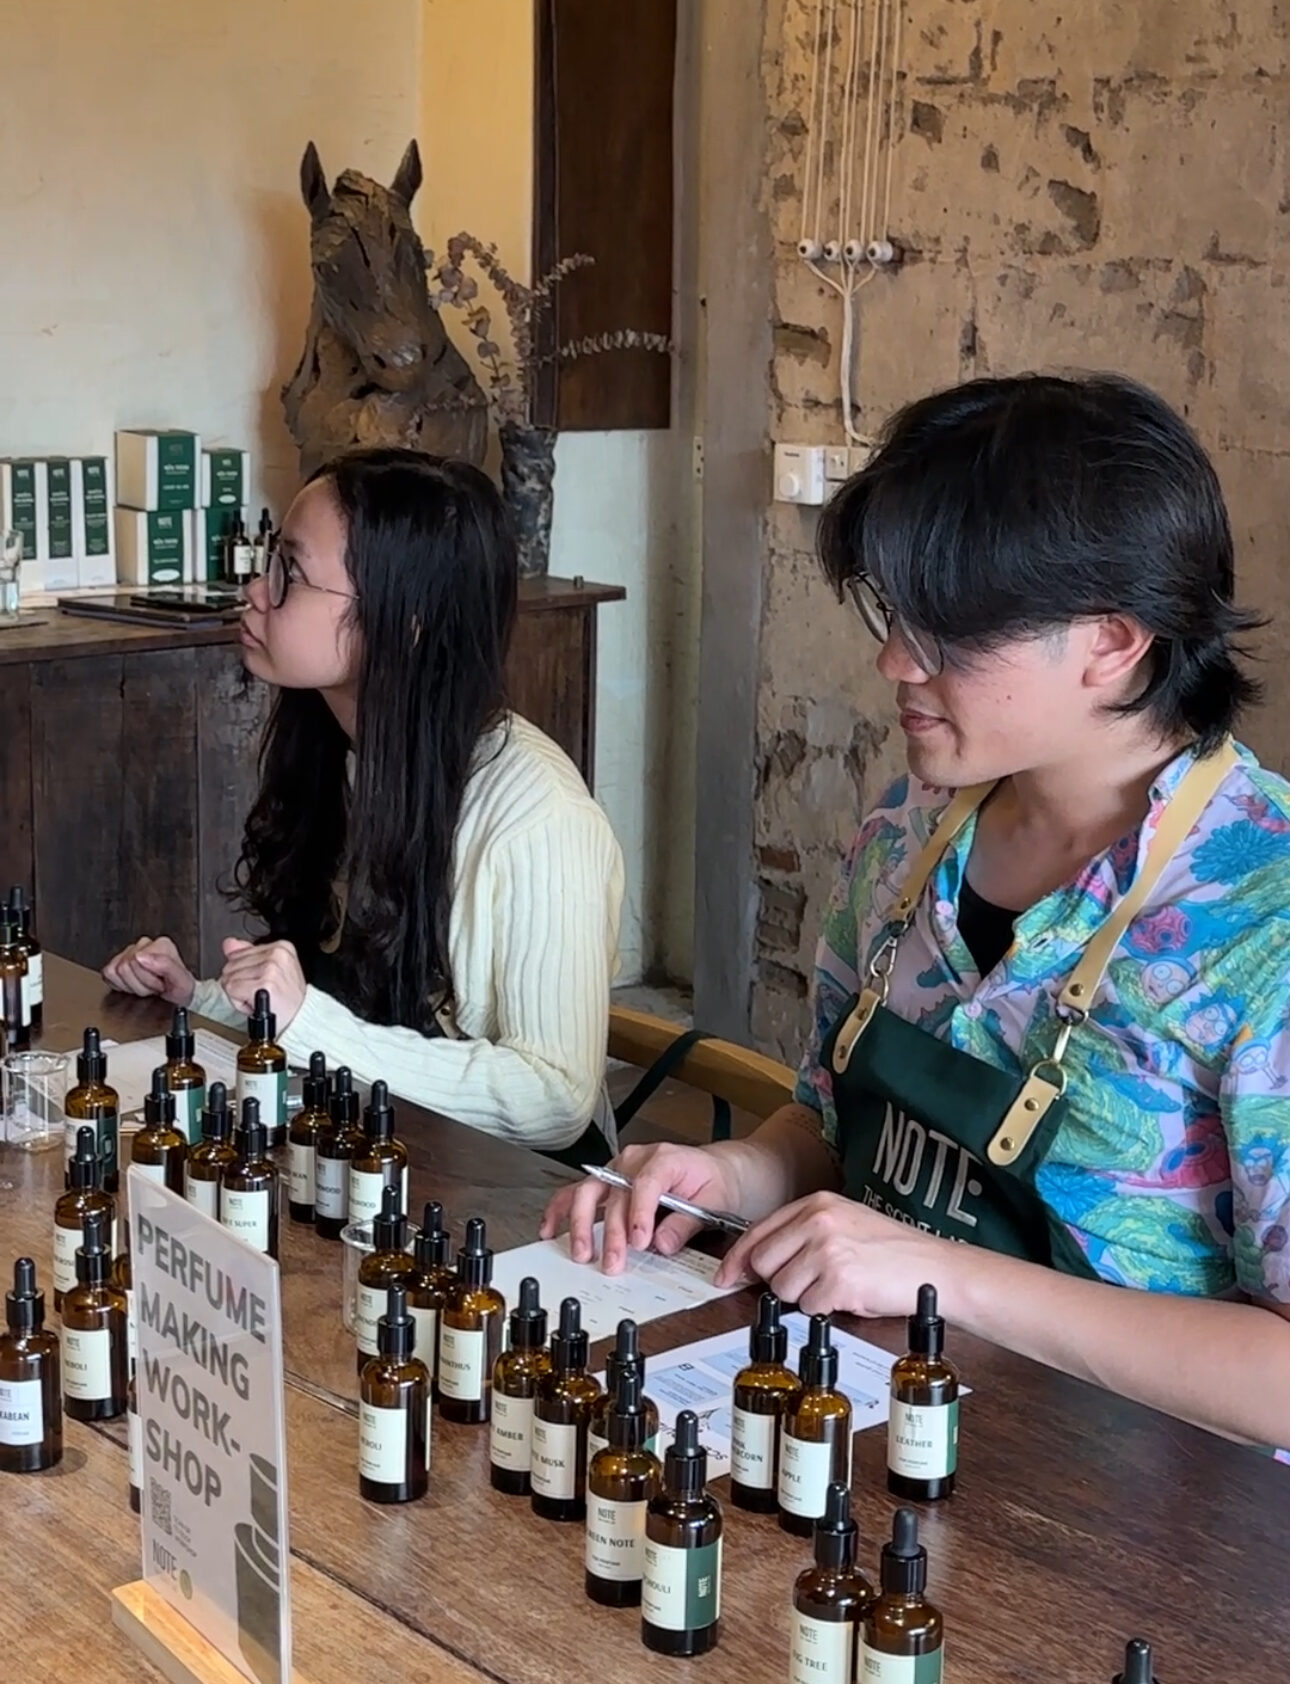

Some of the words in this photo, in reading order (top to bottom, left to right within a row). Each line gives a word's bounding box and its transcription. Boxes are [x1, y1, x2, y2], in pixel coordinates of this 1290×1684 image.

[873, 1101, 983, 1227] NOTE
[138, 1213, 266, 1344] PERFUME
[140, 1281, 250, 1401] MAKING
[143, 1347, 241, 1457] WORK-
[896, 1435, 932, 1448] LEATHER
[146, 1417, 222, 1507] SHOP
[541, 1456, 565, 1468] MUSK
[598, 1506, 616, 1521] NOTE
[609, 1537, 635, 1548] NOTE
[152, 1539, 177, 1581] NOTE
[698, 1577, 708, 1598] NOTE
[800, 1623, 817, 1640] NOTE
[805, 1659, 827, 1672] TREE
[864, 1655, 881, 1672] NOTE
